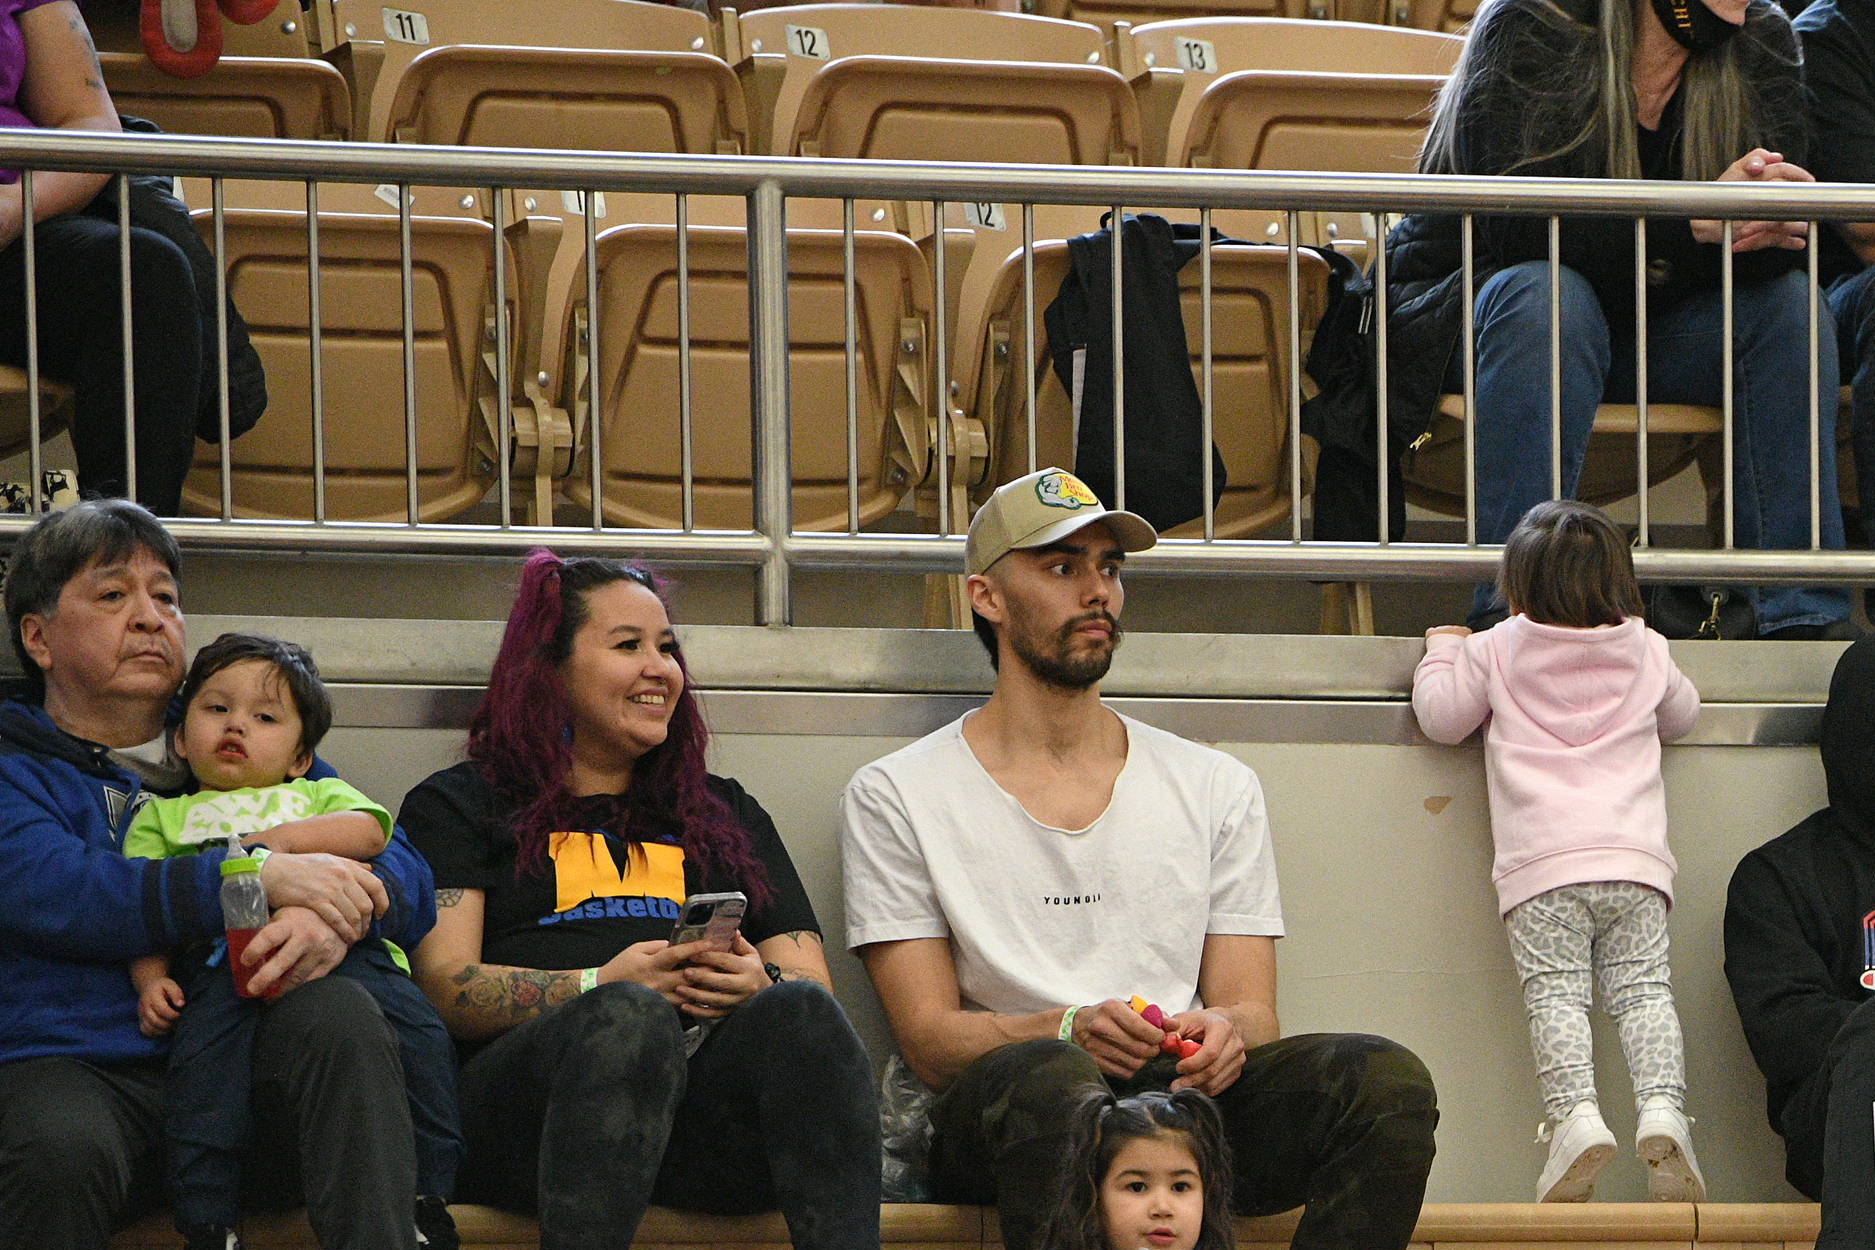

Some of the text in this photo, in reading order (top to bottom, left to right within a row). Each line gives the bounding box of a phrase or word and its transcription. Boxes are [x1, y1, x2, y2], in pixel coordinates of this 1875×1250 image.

[395, 13, 416, 41] 11
[795, 28, 819, 57] 12
[1184, 41, 1206, 70] 13
[976, 202, 995, 227] 12
